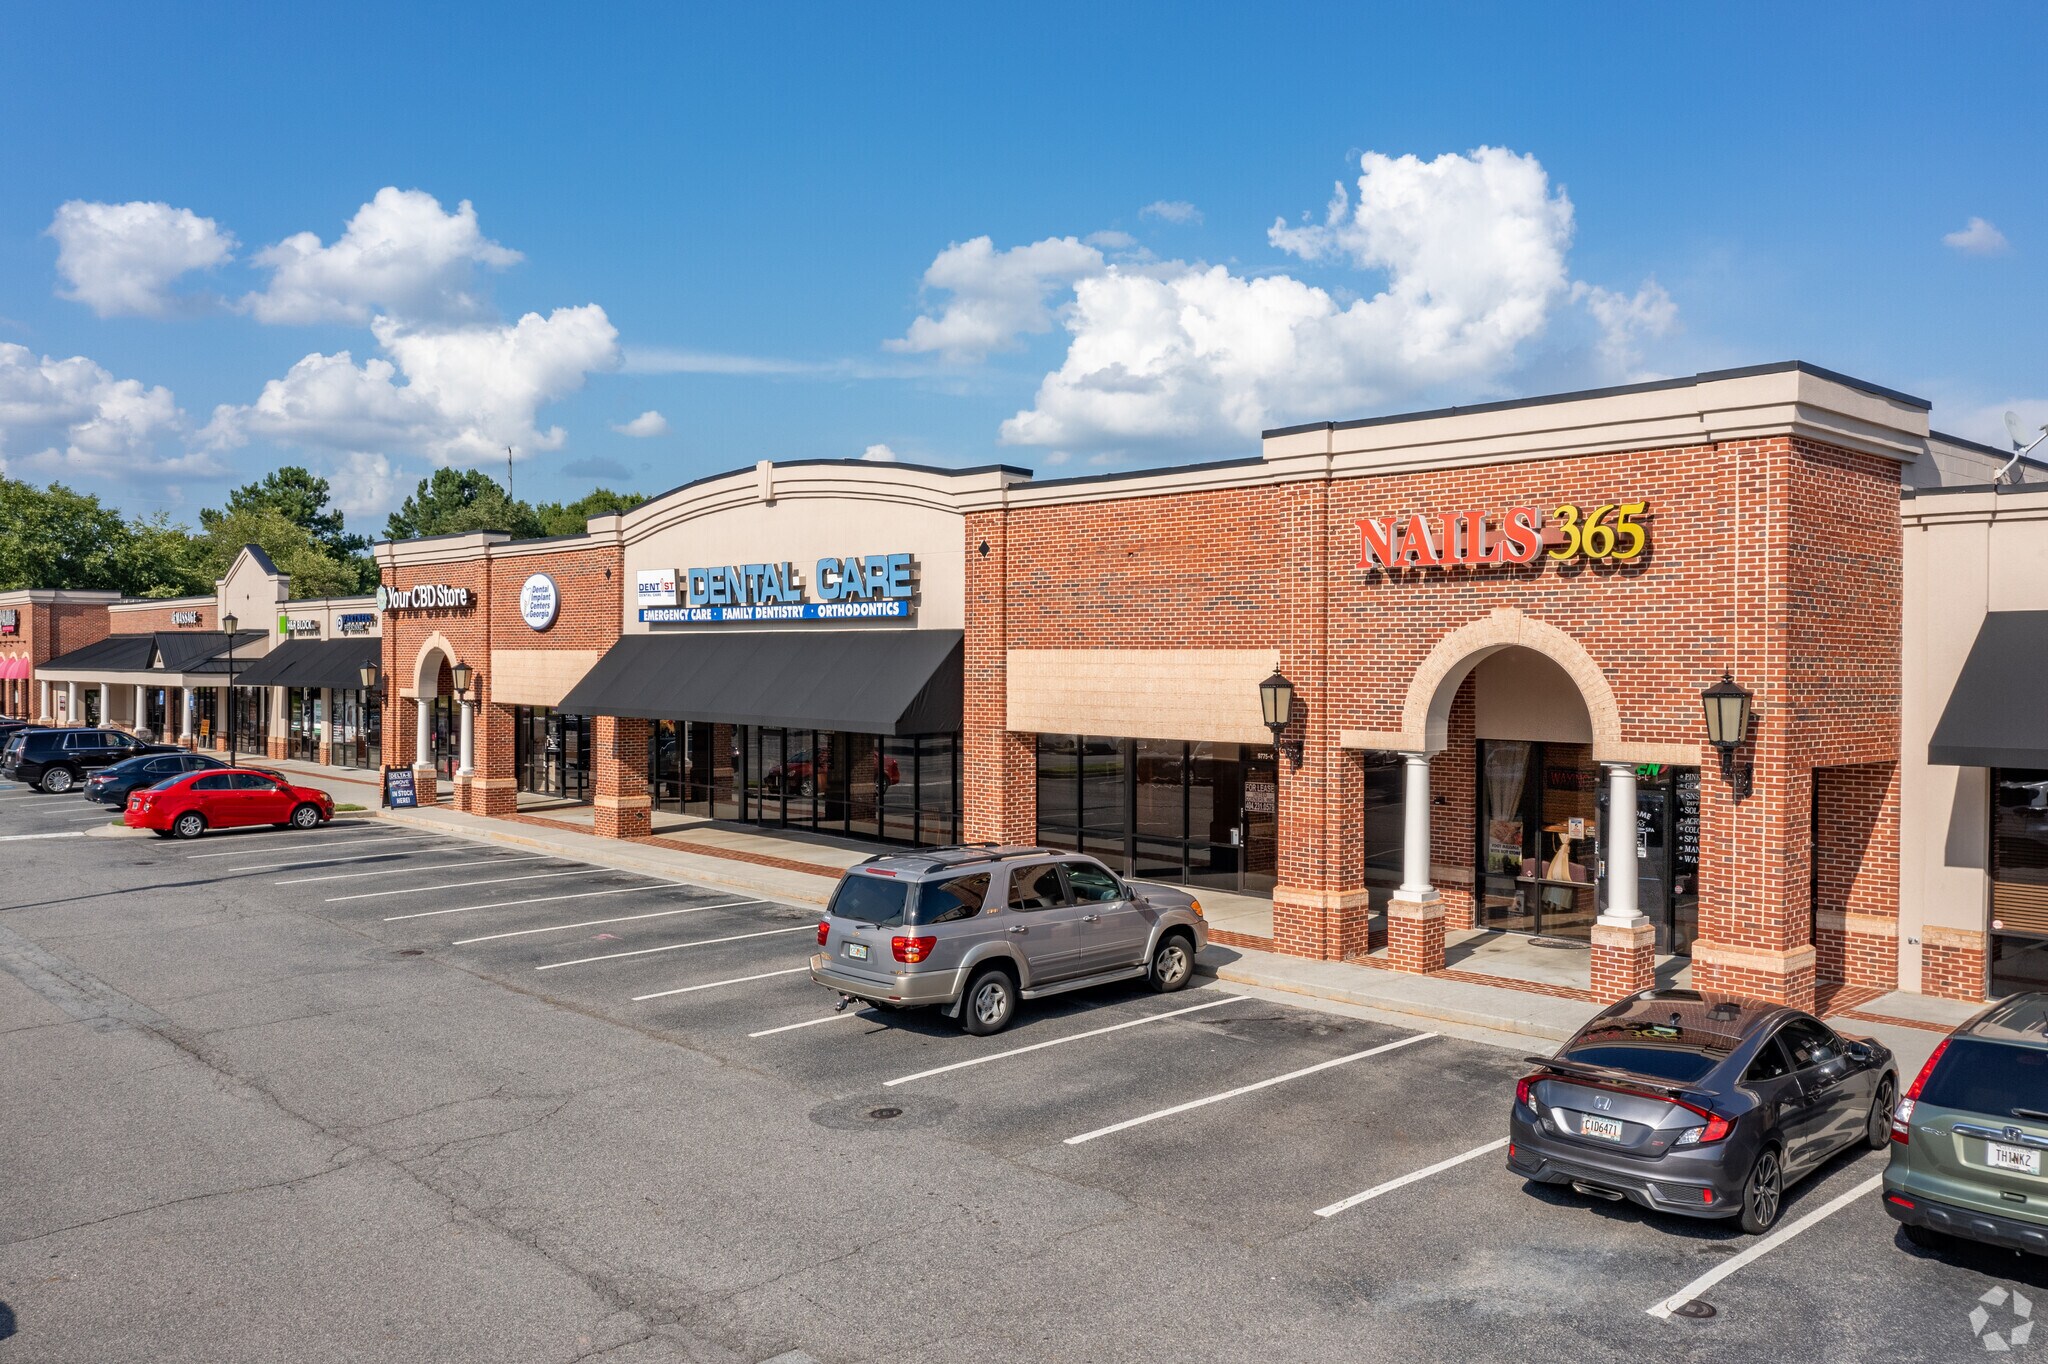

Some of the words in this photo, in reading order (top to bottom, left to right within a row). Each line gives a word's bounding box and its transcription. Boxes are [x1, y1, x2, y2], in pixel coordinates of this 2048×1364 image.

[1355, 507, 1542, 568] NAILS
[1548, 501, 1651, 559] 365
[688, 562, 801, 605] DENTAL
[816, 553, 913, 600] CARE
[532, 585, 550, 593] Dental
[387, 586, 411, 609] Your
[412, 585, 436, 608] CBD
[437, 584, 467, 607] Store
[531, 593, 551, 602] Implant
[530, 602, 551, 610] Centers
[817, 602, 900, 618] ORTHODONTICS
[530, 610, 549, 619] Georgia
[643, 609, 690, 621] EMERGENCY
[690, 608, 712, 620] CARE
[722, 607, 753, 620] FAMILY
[755, 605, 804, 619] DENTISTRY
[297, 619, 312, 630] BLOCK
[1245, 783, 1256, 791] FOR
[1256, 783, 1275, 793] LEASE
[1685, 792, 1700, 800] SNS
[1585, 1119, 1617, 1136] CID6471
